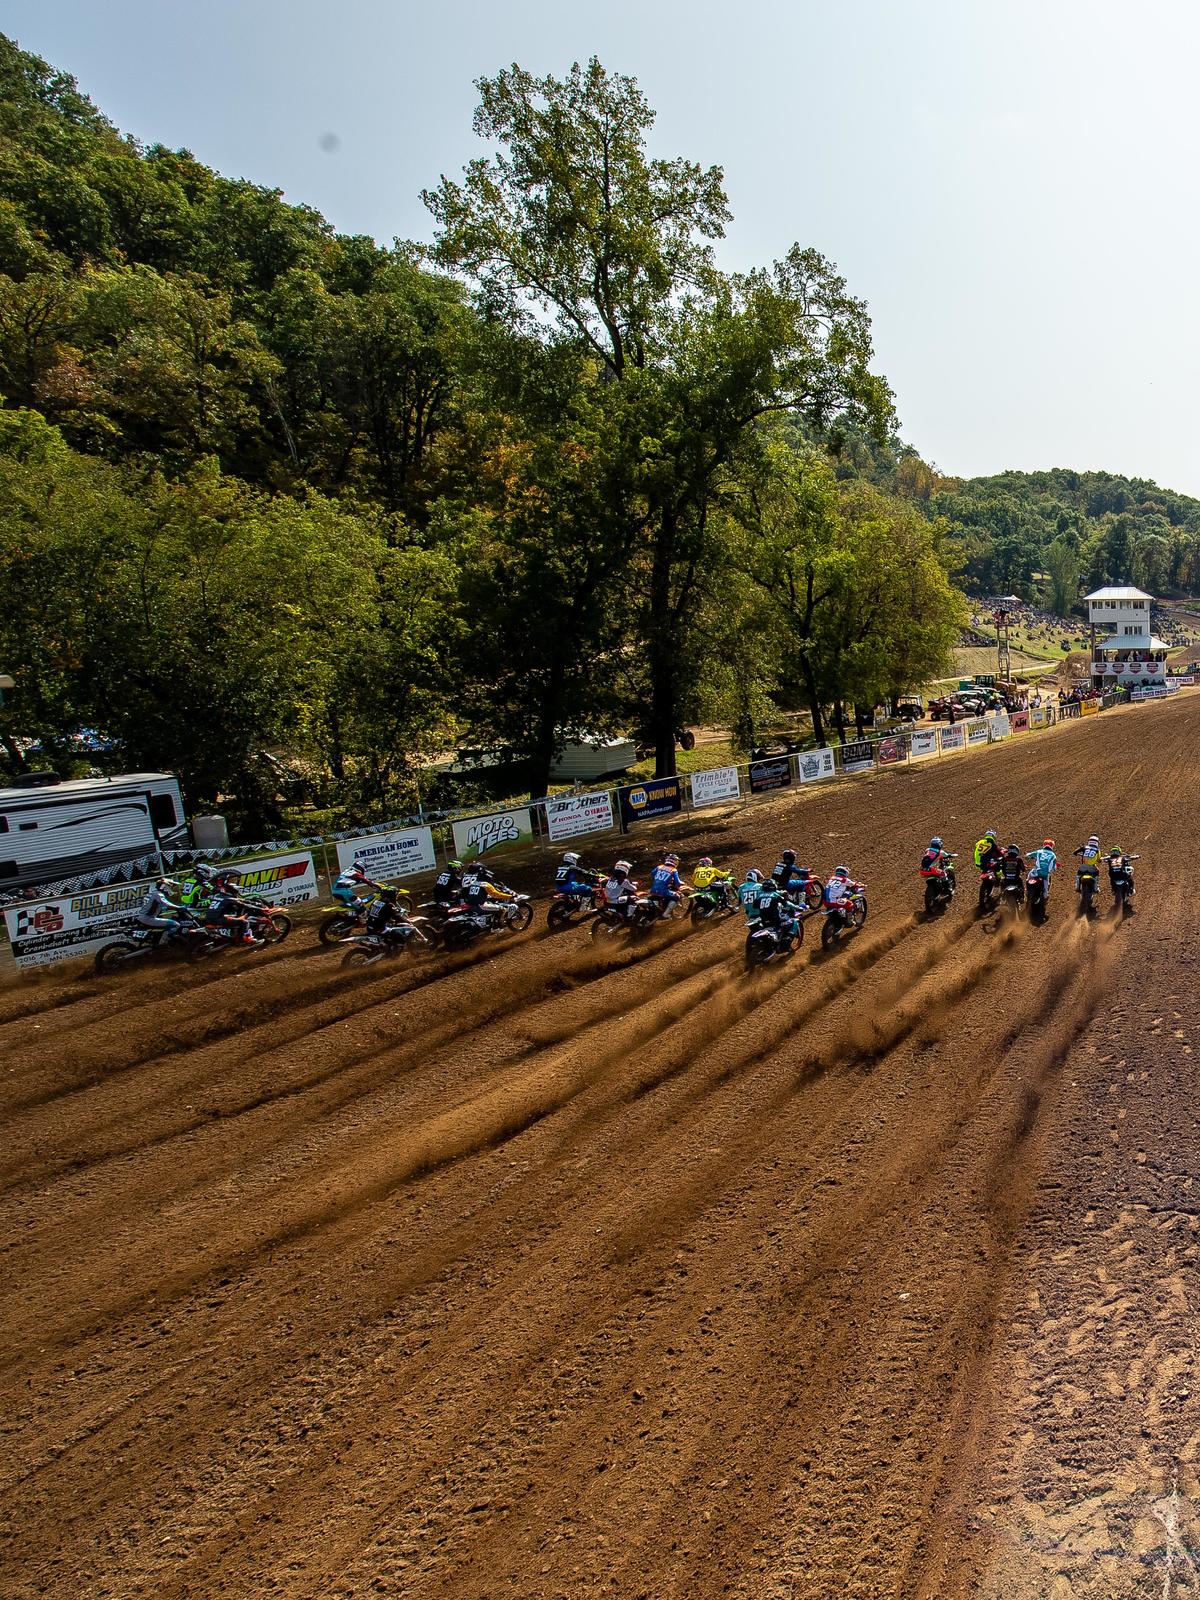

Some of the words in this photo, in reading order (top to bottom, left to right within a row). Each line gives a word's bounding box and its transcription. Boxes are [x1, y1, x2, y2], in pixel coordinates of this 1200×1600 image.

[695, 770, 734, 783] Trimble's
[665, 786, 677, 797] HOW
[558, 814, 582, 823] HONDA
[467, 816, 515, 847] MOTO
[476, 827, 519, 856] TEES
[354, 844, 395, 859] AMERICAN
[397, 839, 419, 851] HOME
[293, 883, 314, 892] YAMAHA
[71, 895, 103, 912] BILL
[107, 885, 150, 904] BUNE
[18, 935, 51, 947] Cylinder
